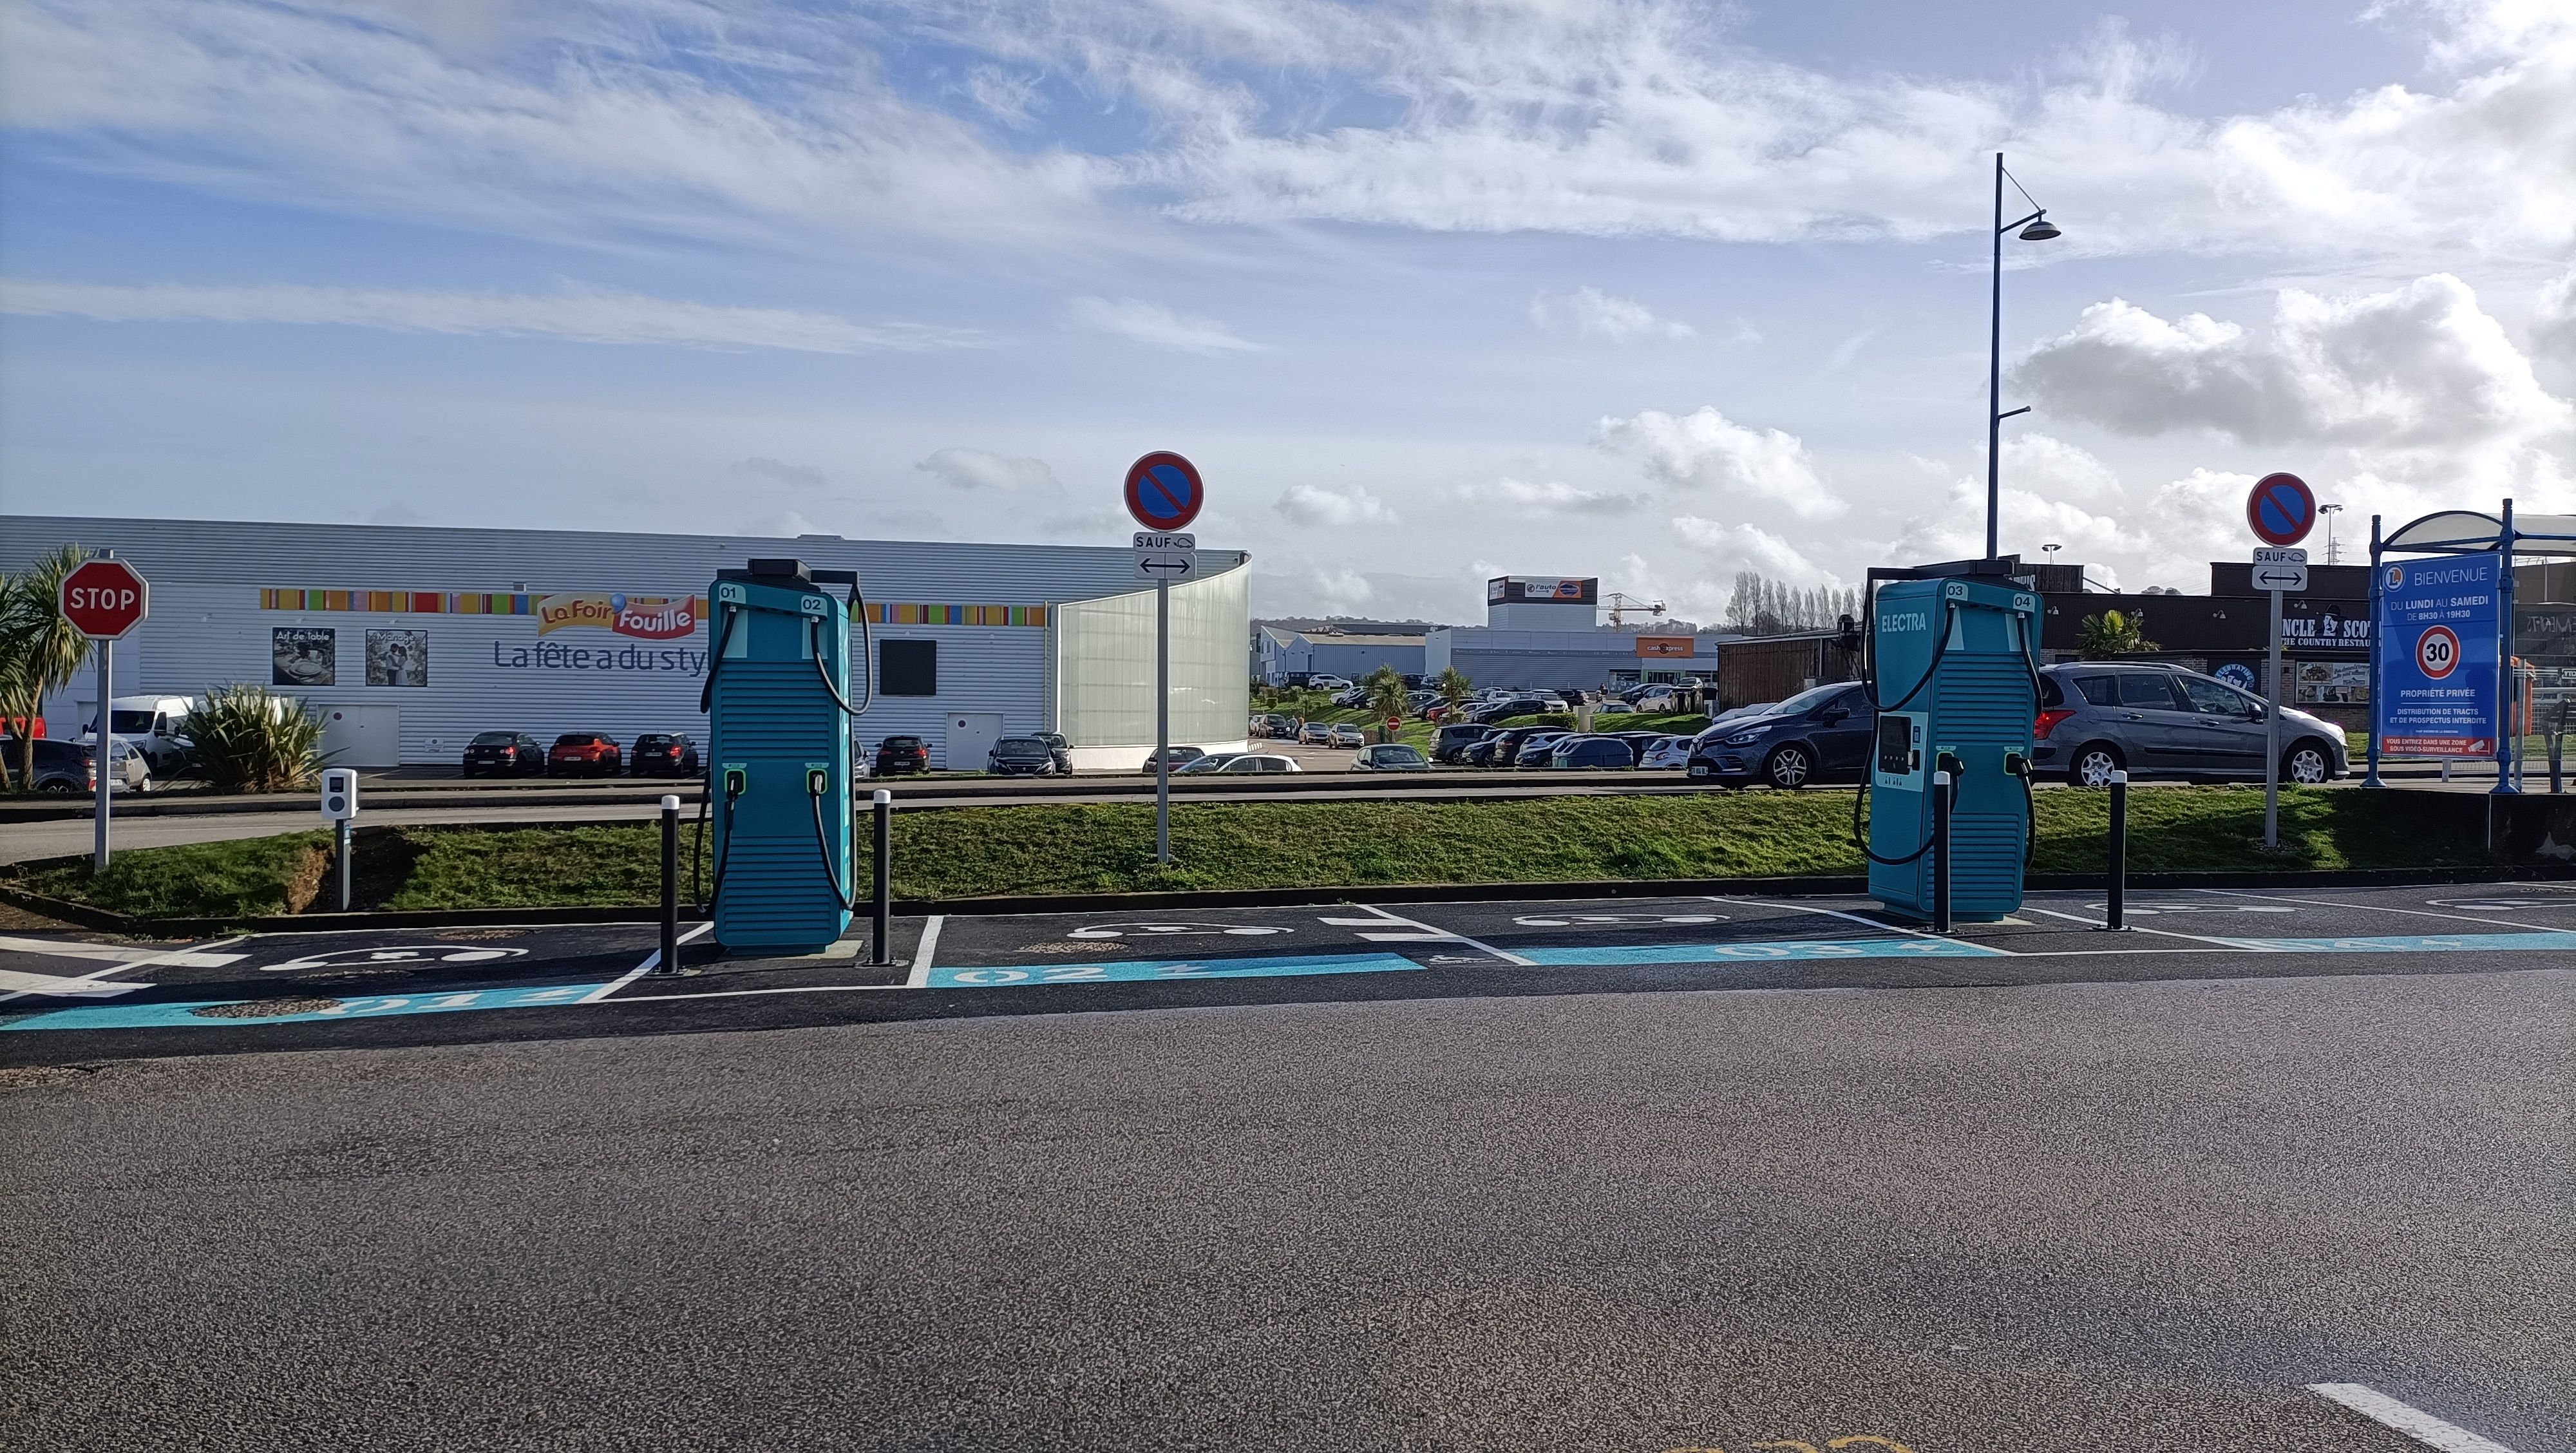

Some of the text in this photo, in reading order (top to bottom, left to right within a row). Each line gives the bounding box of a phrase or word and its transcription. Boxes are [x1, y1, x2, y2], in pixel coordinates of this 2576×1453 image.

[1136, 537, 1171, 547] SAUF
[2256, 551, 2286, 562] SAUF
[2414, 567, 2488, 586] BIENVENUE
[721, 587, 736, 598] 01
[1947, 585, 1963, 596] 03
[70, 587, 135, 610] STOP
[802, 599, 821, 610] 02
[2014, 596, 2031, 607] 04
[2391, 596, 2488, 611] DU LUNDI AU SAMEDI
[541, 605, 570, 625] La
[619, 609, 692, 632] Fouille
[2418, 612, 2438, 620] 8H30
[2439, 609, 2445, 619] À
[2447, 610, 2470, 619] 19H30
[1882, 613, 1926, 632] ELECTRA
[2282, 619, 2315, 637] NCLE
[276, 631, 330, 641] Art de table
[2298, 638, 2338, 647] COUNTRY
[495, 641, 528, 669] La
[533, 641, 590, 669] fête
[596, 649, 612, 670] a
[619, 643, 653, 670] du
[2427, 643, 2449, 661] 30
[2400, 687, 2476, 698] PROPRIÉTÉ PRIVÉE
[1715, 944, 1865, 956] 03
[952, 966, 1108, 983] 02
[318, 992, 483, 1015] 01
